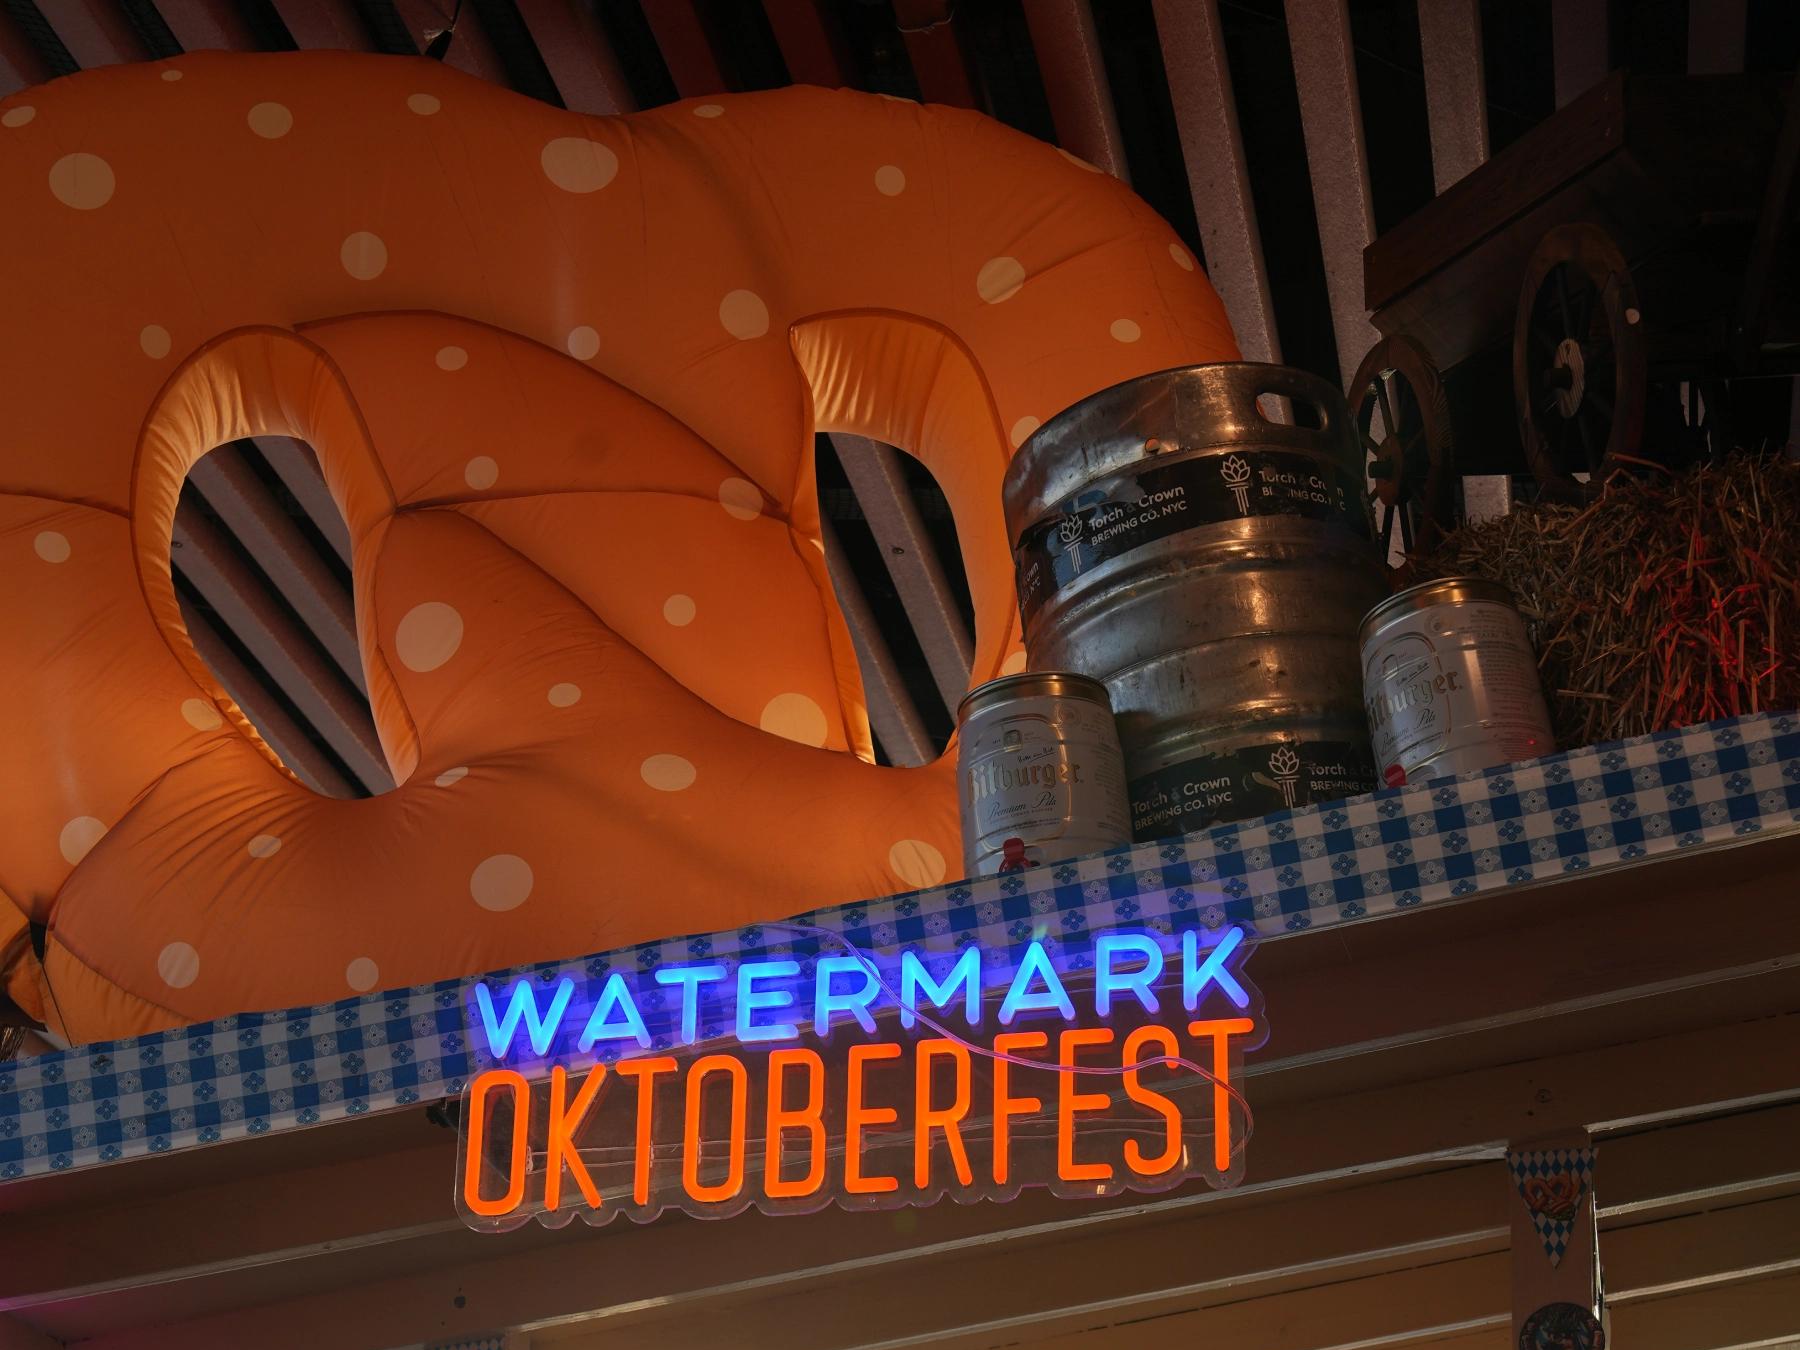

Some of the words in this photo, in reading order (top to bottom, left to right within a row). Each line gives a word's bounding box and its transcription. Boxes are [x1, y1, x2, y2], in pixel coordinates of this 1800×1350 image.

[1088, 507, 1124, 532] Torch
[1139, 485, 1186, 508] Crown
[1091, 520, 1138, 547] BREWING
[1139, 508, 1161, 528] CO.
[1162, 499, 1188, 517] NYC
[1309, 763, 1347, 777] Torch
[1033, 791, 1057, 809] Pils
[1131, 792, 1168, 815] Torch
[1183, 775, 1231, 797] Crown
[1134, 806, 1183, 832] BREWING
[1184, 799, 1205, 812] CO.
[1207, 791, 1233, 807] NYC
[474, 925, 1250, 1059] WATERMARK
[462, 1017, 1255, 1218] OKTOBERFEST
